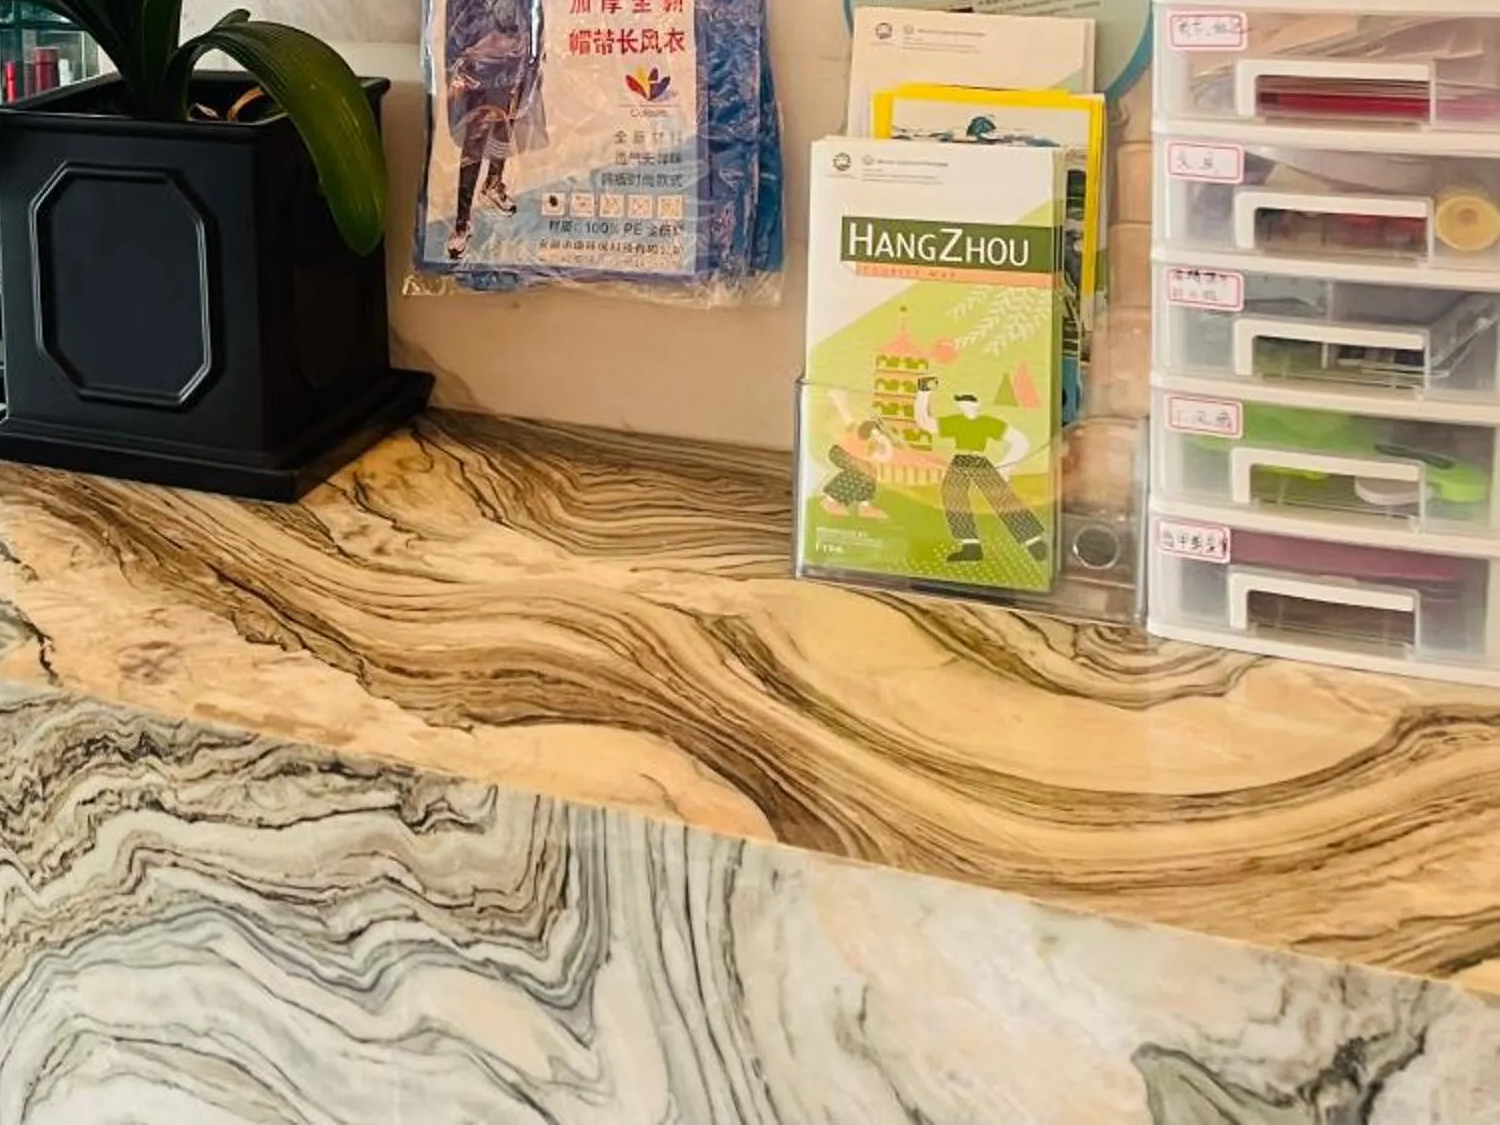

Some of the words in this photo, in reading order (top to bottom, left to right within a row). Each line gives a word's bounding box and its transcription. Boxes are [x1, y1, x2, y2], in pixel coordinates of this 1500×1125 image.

[569, 26, 686, 56] 帽带长风衣
